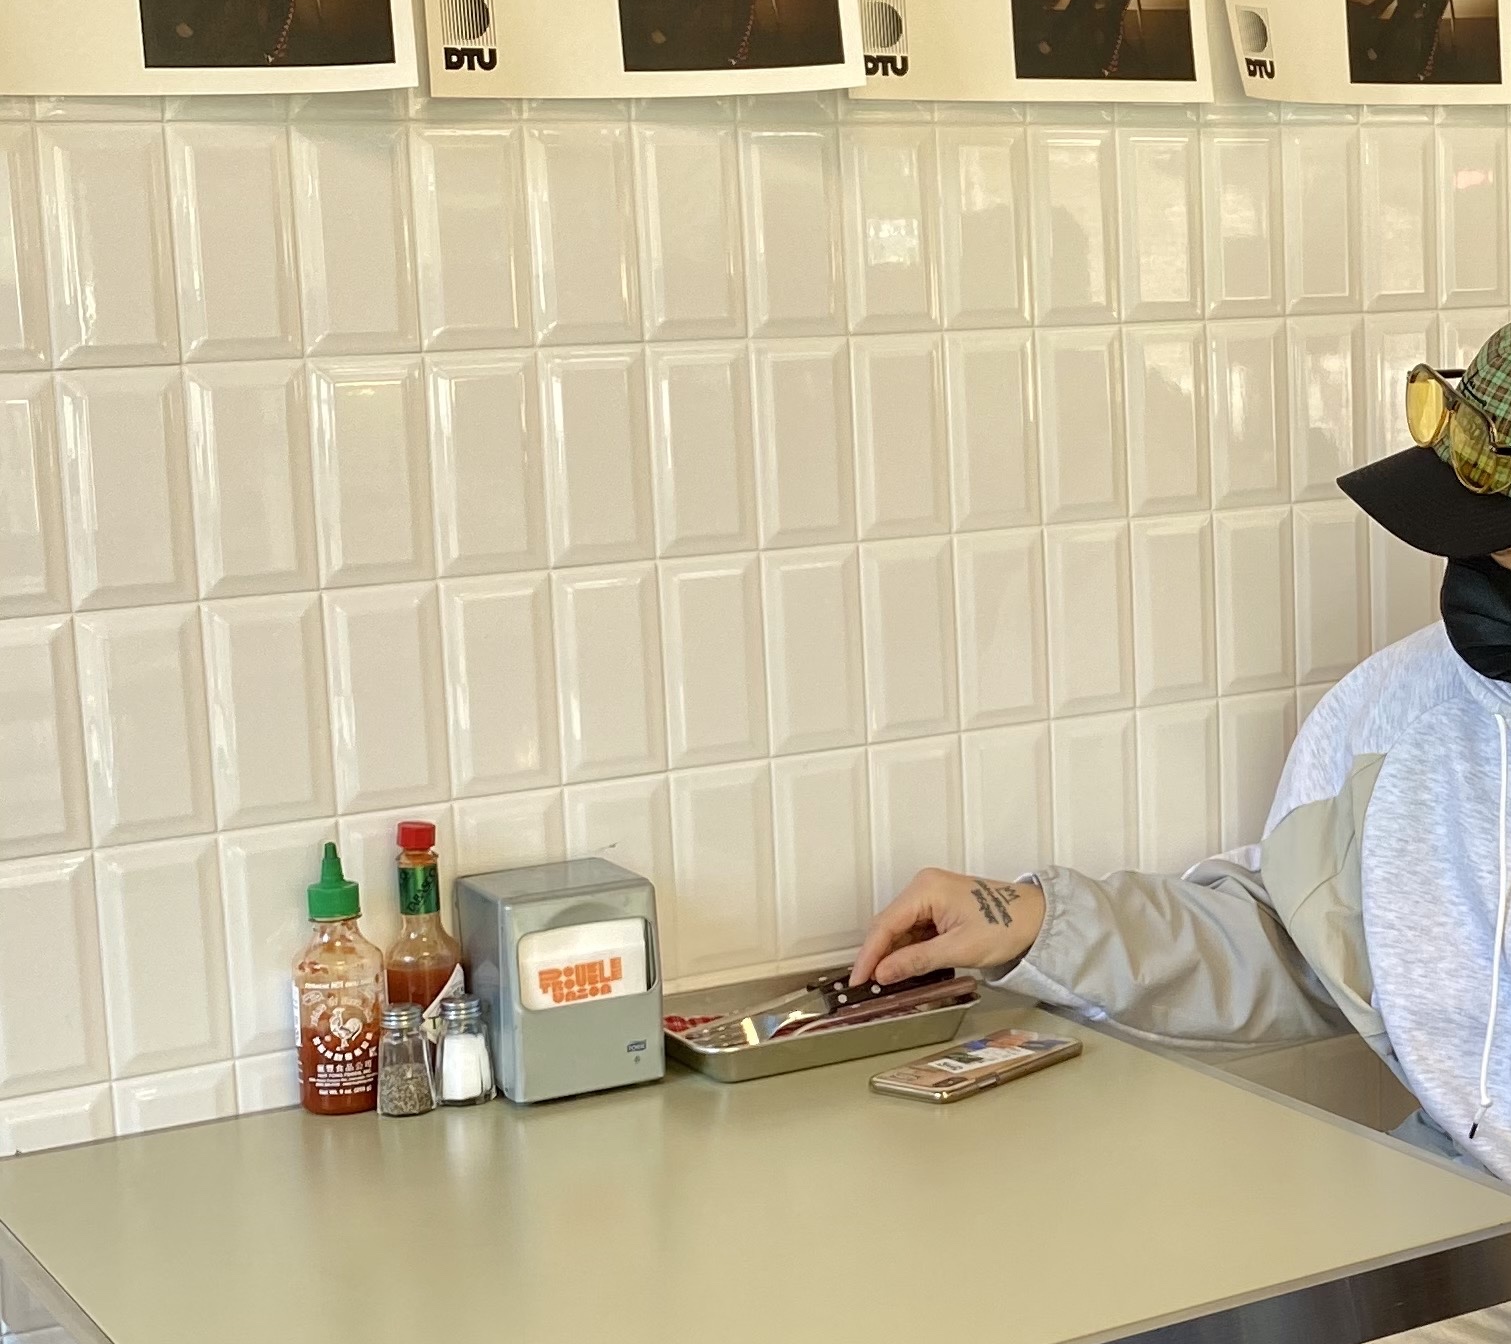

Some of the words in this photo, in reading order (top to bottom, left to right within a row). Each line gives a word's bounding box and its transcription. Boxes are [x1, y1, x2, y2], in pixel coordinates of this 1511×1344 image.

[443, 46, 498, 72] DTU
[863, 54, 909, 77] DTU
[1244, 57, 1276, 80] DTU
